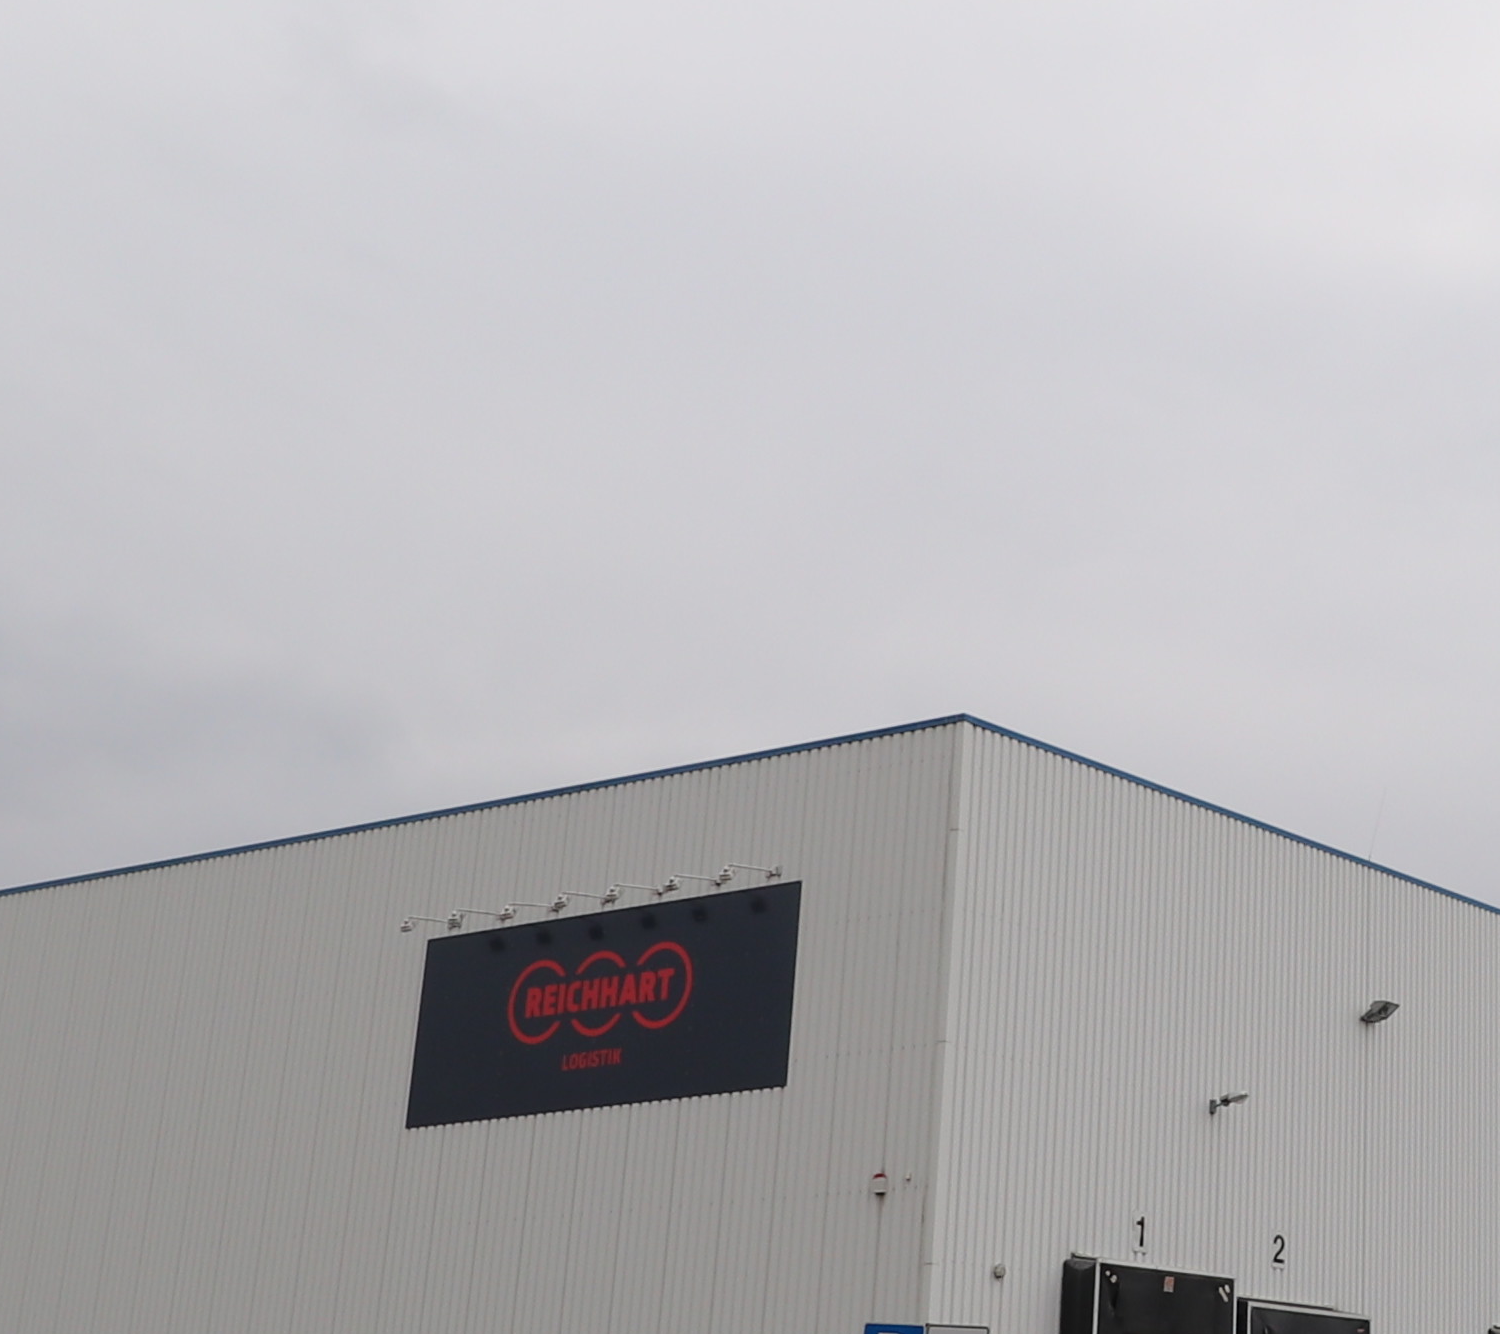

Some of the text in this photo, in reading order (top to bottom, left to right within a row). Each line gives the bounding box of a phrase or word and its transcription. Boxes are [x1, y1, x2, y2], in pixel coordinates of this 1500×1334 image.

[524, 967, 676, 1019] REICHHART
[561, 1047, 623, 1071] LOGISTIK
[1136, 1216, 1146, 1248] 1
[1273, 1234, 1286, 1265] 2
